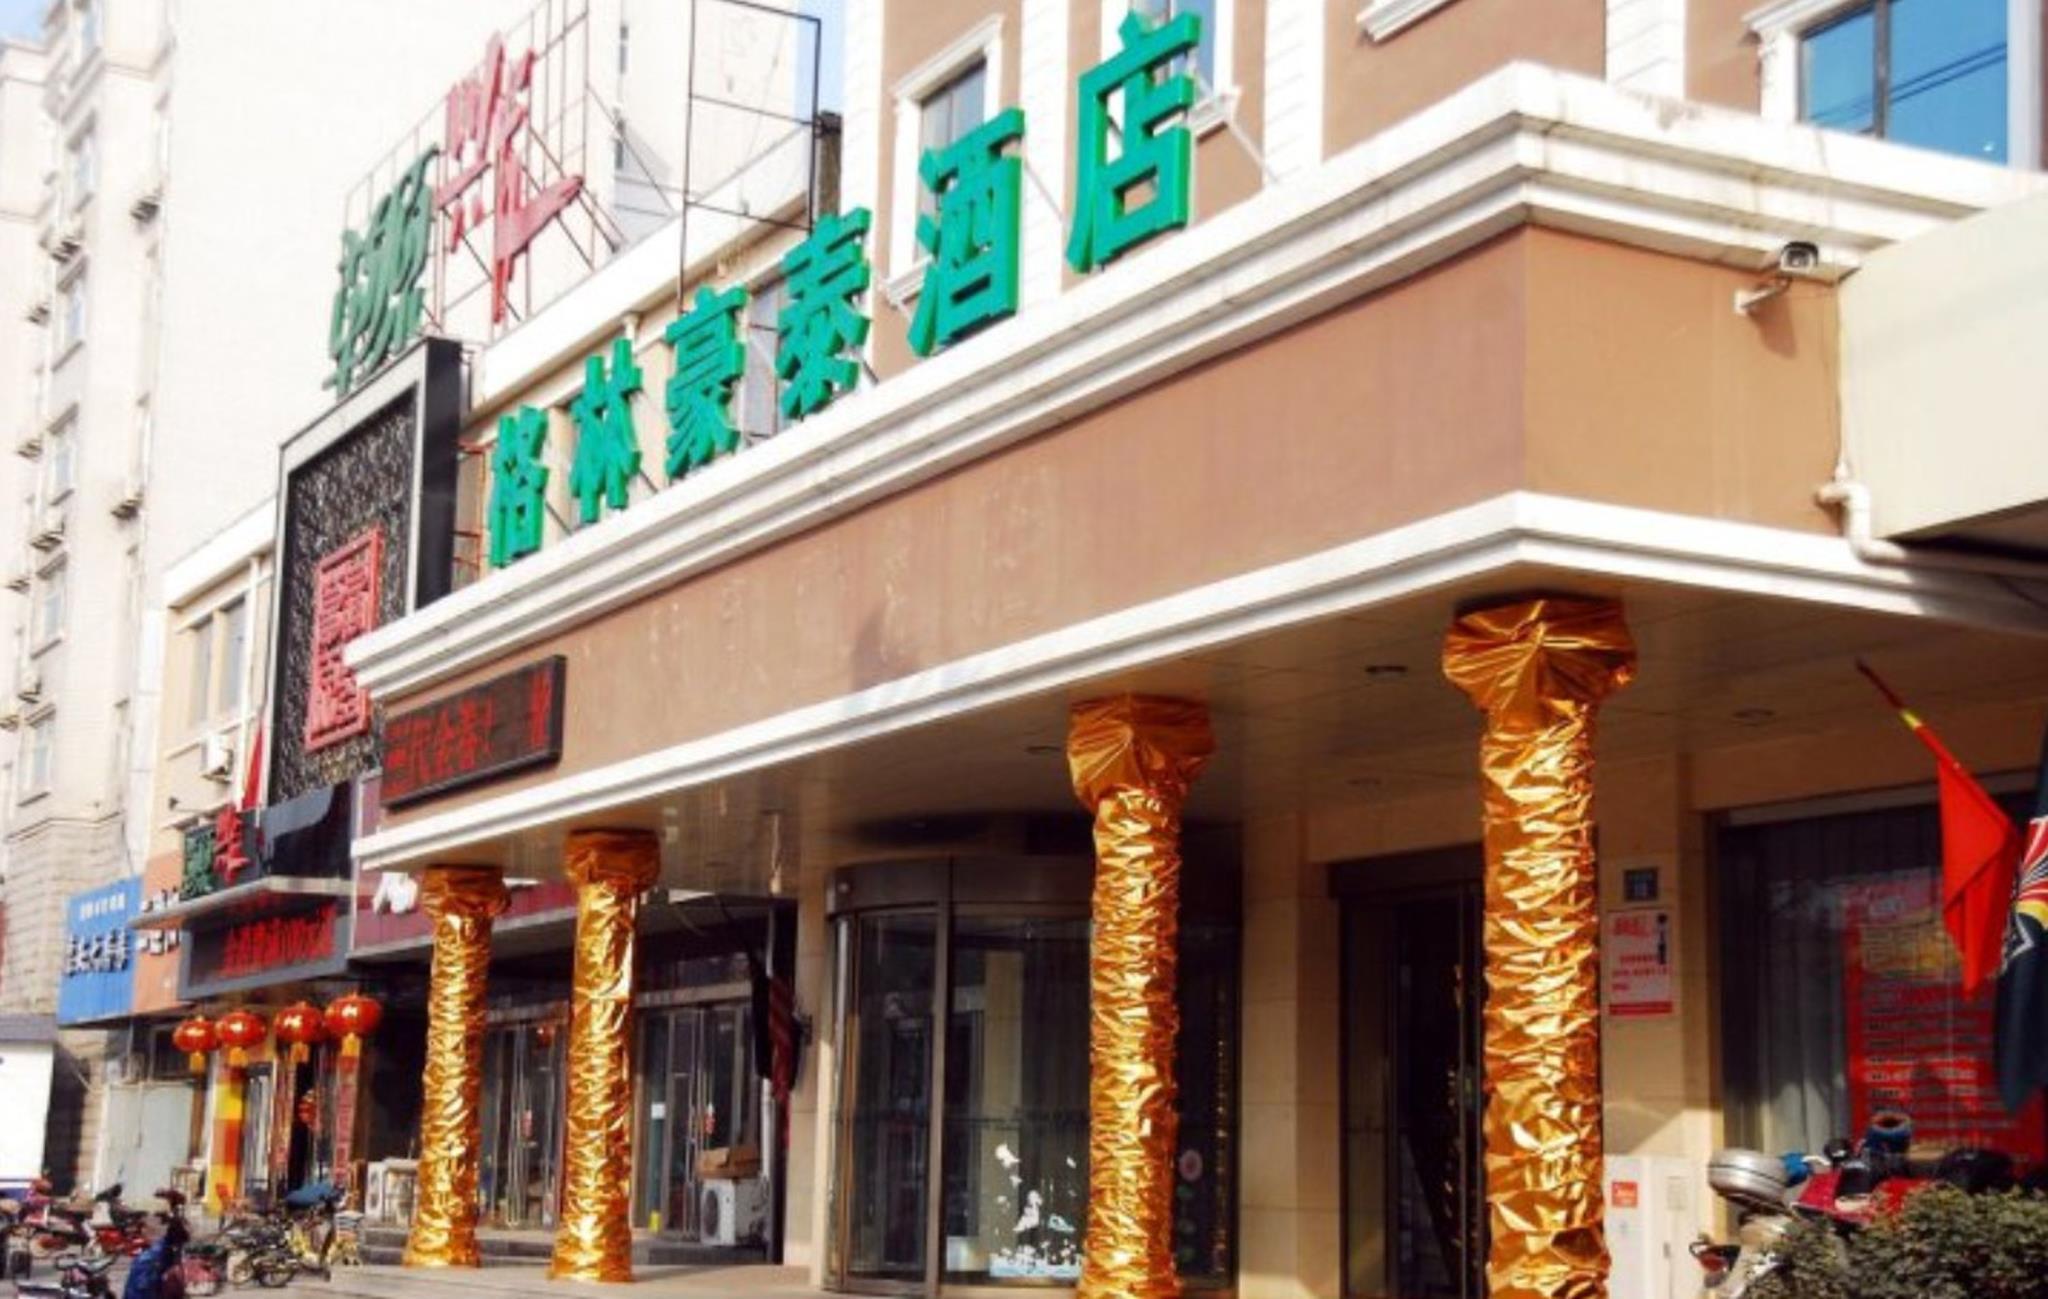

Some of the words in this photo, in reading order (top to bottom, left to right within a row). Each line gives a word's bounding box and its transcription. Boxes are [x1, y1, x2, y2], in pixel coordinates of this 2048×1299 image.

[487, 11, 1202, 568] 格林豪泰酒店
